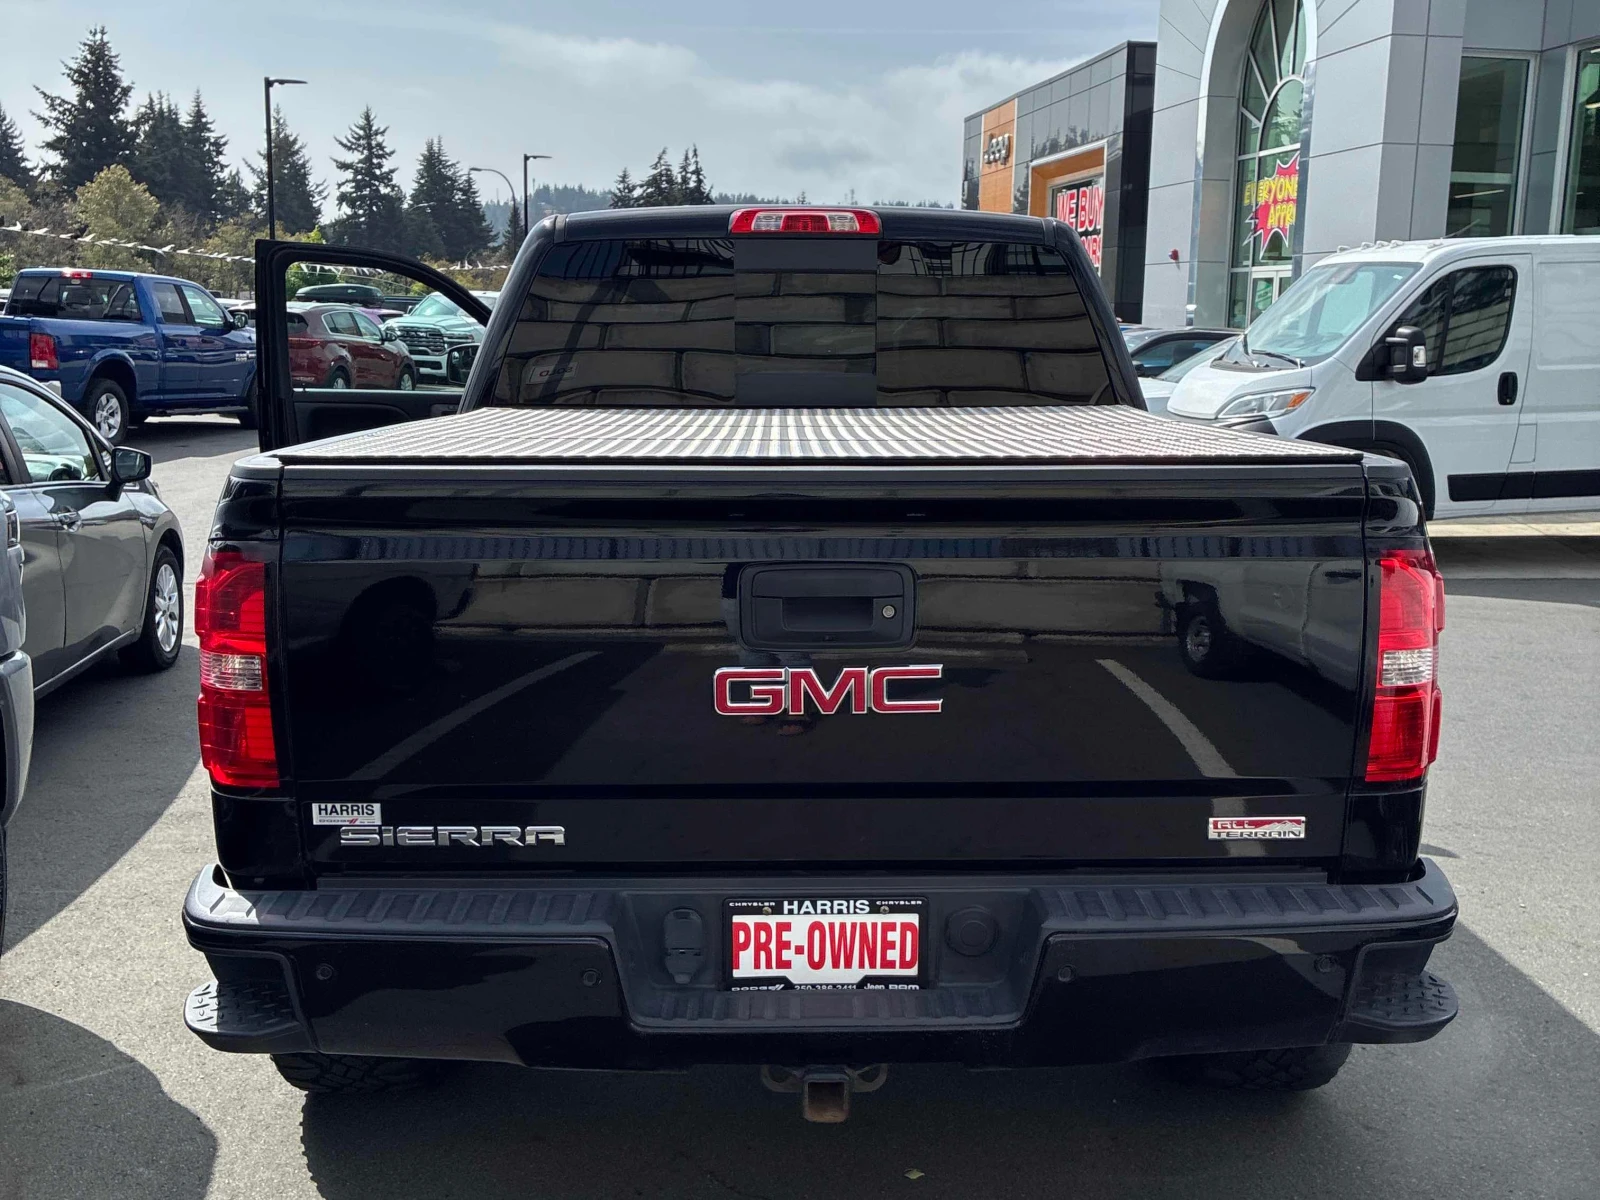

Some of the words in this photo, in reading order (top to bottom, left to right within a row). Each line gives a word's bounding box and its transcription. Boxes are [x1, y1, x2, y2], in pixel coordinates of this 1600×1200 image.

[1057, 189, 1077, 230] WE
[1078, 185, 1103, 232] BUY
[714, 664, 944, 715] GMC
[318, 803, 375, 816] HARRIS
[1217, 820, 1256, 829] ALL
[340, 826, 566, 847] SIERRA
[1212, 830, 1302, 838] TERRAIN
[783, 900, 870, 915] HARRIS
[732, 920, 918, 971] PRE-OWNED
